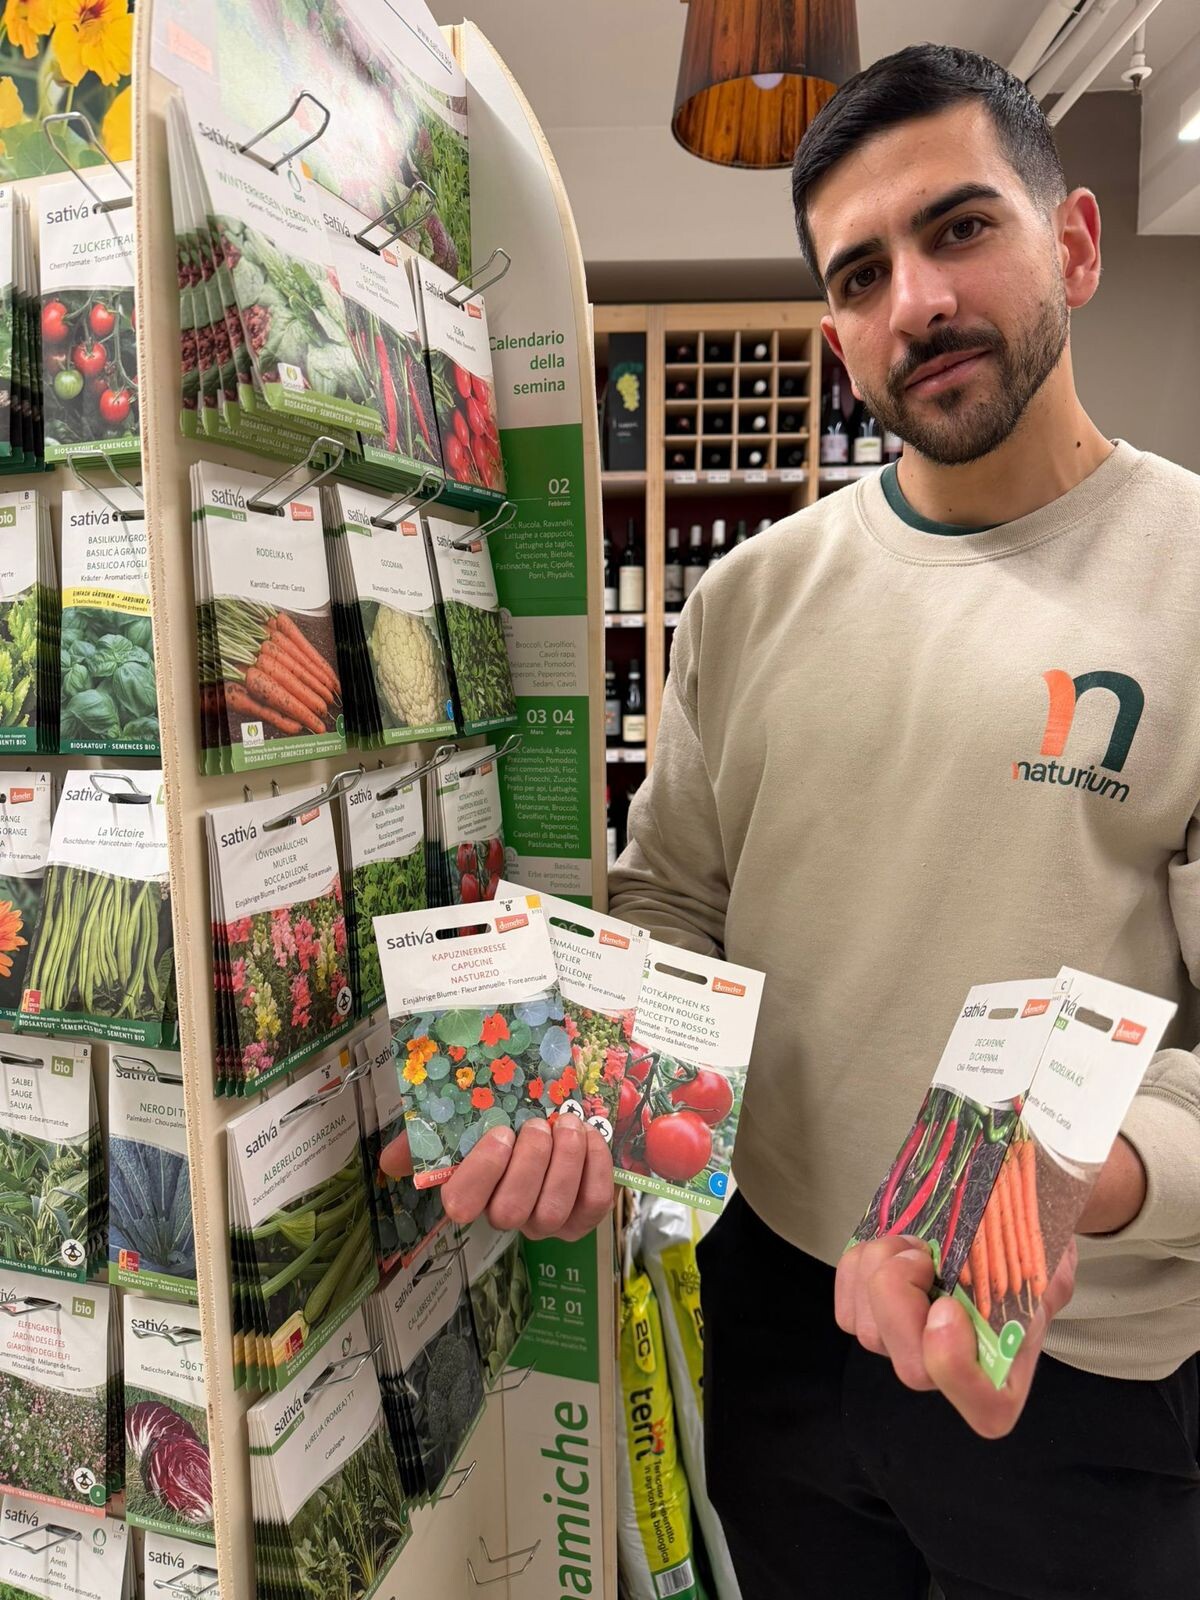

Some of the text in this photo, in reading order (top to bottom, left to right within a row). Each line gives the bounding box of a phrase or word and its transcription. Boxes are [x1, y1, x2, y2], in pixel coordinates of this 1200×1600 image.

[46, 200, 89, 224] sativa
[322, 213, 351, 238] sativa
[489, 331, 565, 352] Calendario
[529, 353, 565, 371] della
[513, 378, 566, 395] semina
[99, 440, 133, 450] SEMENCES
[548, 478, 570, 495] 02
[211, 486, 246, 510] sativa
[70, 506, 110, 527] sativa
[88, 534, 130, 545] BASILIKUM
[86, 547, 114, 558] BASILIC
[120, 546, 147, 557] GRAND
[256, 547, 286, 559] RODELIKA
[86, 560, 119, 570] BASILICO
[104, 572, 141, 583] Aromatiques
[526, 709, 547, 724] 03
[552, 709, 575, 724] 04
[1042, 668, 1145, 773] n
[70, 742, 107, 750] BIOSAATGUT
[1010, 760, 1130, 803] naturium
[65, 784, 103, 802] sativa
[349, 783, 373, 806] sativa
[97, 826, 145, 840] La Victoire
[220, 817, 257, 849] sativa
[505, 903, 512, 912] B
[386, 925, 435, 950] sativa
[601, 933, 627, 946] demeter
[638, 929, 644, 938] B
[431, 942, 508, 962] KAPUZINERKRESSE
[451, 957, 494, 972] CAPUCINE
[567, 965, 593, 981] LEONE
[450, 969, 500, 985] NASTURZIO
[402, 972, 548, 1007] Einjährige Blume Fleur annuelle Fiore annuale
[559, 975, 626, 1001] annuelle Fiore annuale
[641, 984, 711, 1013] ROTKÄPPCHEN KS
[675, 1008, 716, 1026] ROUGE KS
[961, 998, 988, 1019] sativa
[19, 1019, 56, 1030] BIOSAATGUT
[93, 1026, 104, 1035] BIO
[106, 1030, 134, 1041] SEMENTI
[134, 1033, 146, 1042] BIO
[634, 1026, 699, 1052] Pomodoro da balcone
[664, 1026, 717, 1048] Tomate de balcon
[680, 1021, 708, 1035] ROSSO
[709, 1030, 720, 1040] KS
[53, 1060, 70, 1075] bio
[1048, 1059, 1085, 1089] RODELIKA KS
[11, 1077, 33, 1087] SALBEI
[10, 1089, 33, 1099] SAUGE
[9, 1100, 33, 1111] SALVIA
[139, 1102, 178, 1117] NERO DI
[245, 1117, 279, 1159] sativa
[263, 1145, 304, 1185] ALBERELLO
[311, 1113, 347, 1147] SARZANA
[613, 1171, 712, 1206] EMENCES BIO SEMENTI BIO
[41, 1267, 66, 1277] SEMENTI
[66, 1271, 78, 1279] BIO
[538, 1263, 580, 1282] 10 11
[118, 1275, 154, 1288] BIOSAATGUT
[158, 1283, 188, 1295] SEMENCES
[75, 1301, 92, 1315] bio
[540, 1295, 582, 1316] 12 01
[18, 1320, 62, 1336] ELFENGARTEN
[6, 1341, 39, 1355] GIARDINO
[12, 1331, 66, 1349] JARDIN DES ELFES
[180, 1359, 198, 1371] 506
[273, 1390, 303, 1437] sativa
[303, 1424, 325, 1453] AURELIA
[4, 1508, 40, 1528] sativa
[652, 1520, 670, 1565] biologica
[49, 1556, 68, 1569] Aneth
[148, 1551, 185, 1569] sativa
[8, 1567, 28, 1580] Kräuter
[48, 1568, 67, 1580] Aneto
